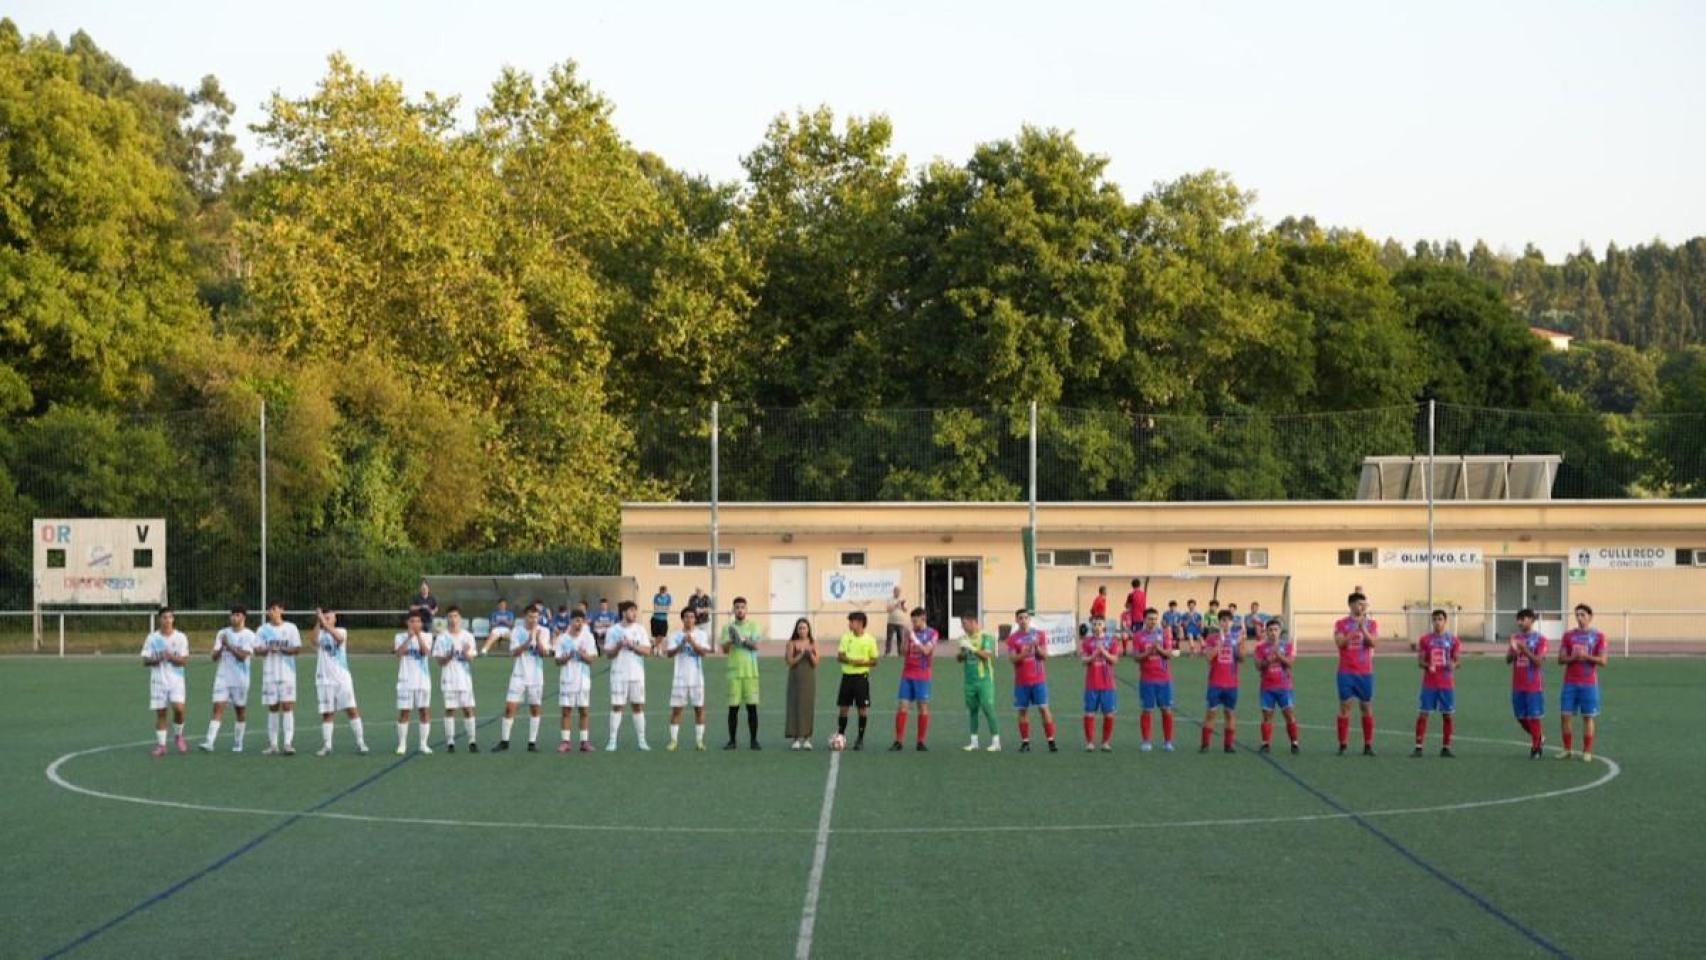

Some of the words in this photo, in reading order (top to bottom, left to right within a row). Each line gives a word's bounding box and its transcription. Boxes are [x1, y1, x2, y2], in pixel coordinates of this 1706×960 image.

[41, 525, 71, 543] OR
[136, 525, 149, 543] V
[1599, 548, 1665, 559] CULLEREDO
